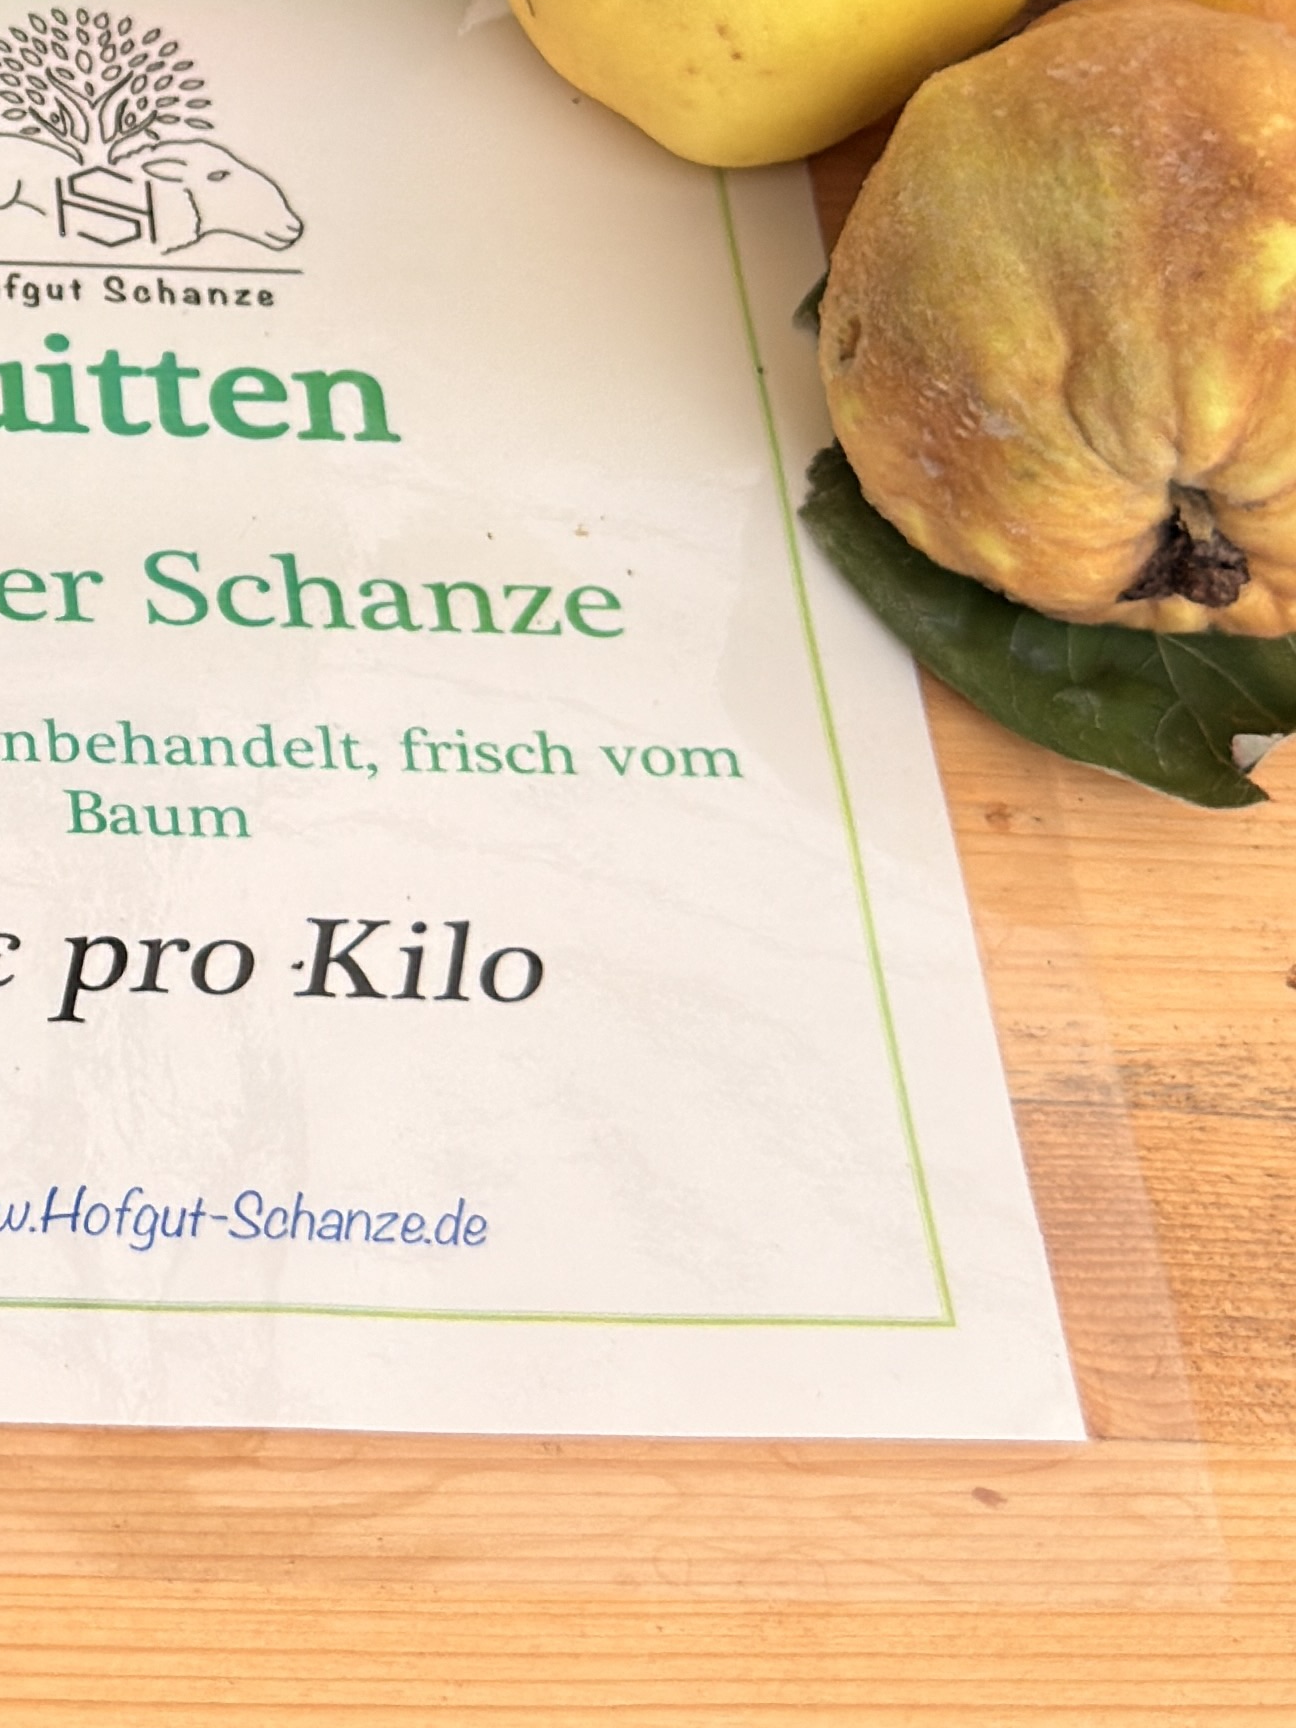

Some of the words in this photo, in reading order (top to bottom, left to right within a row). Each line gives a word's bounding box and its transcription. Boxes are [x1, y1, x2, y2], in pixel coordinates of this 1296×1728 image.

[103, 275, 275, 307] Schanze
[144, 548, 626, 639] Schanze
[399, 726, 578, 776] frisch
[599, 742, 743, 779] vom
[63, 788, 251, 839] Baum
[47, 934, 256, 1023] pro
[294, 916, 544, 1003] Kilo
